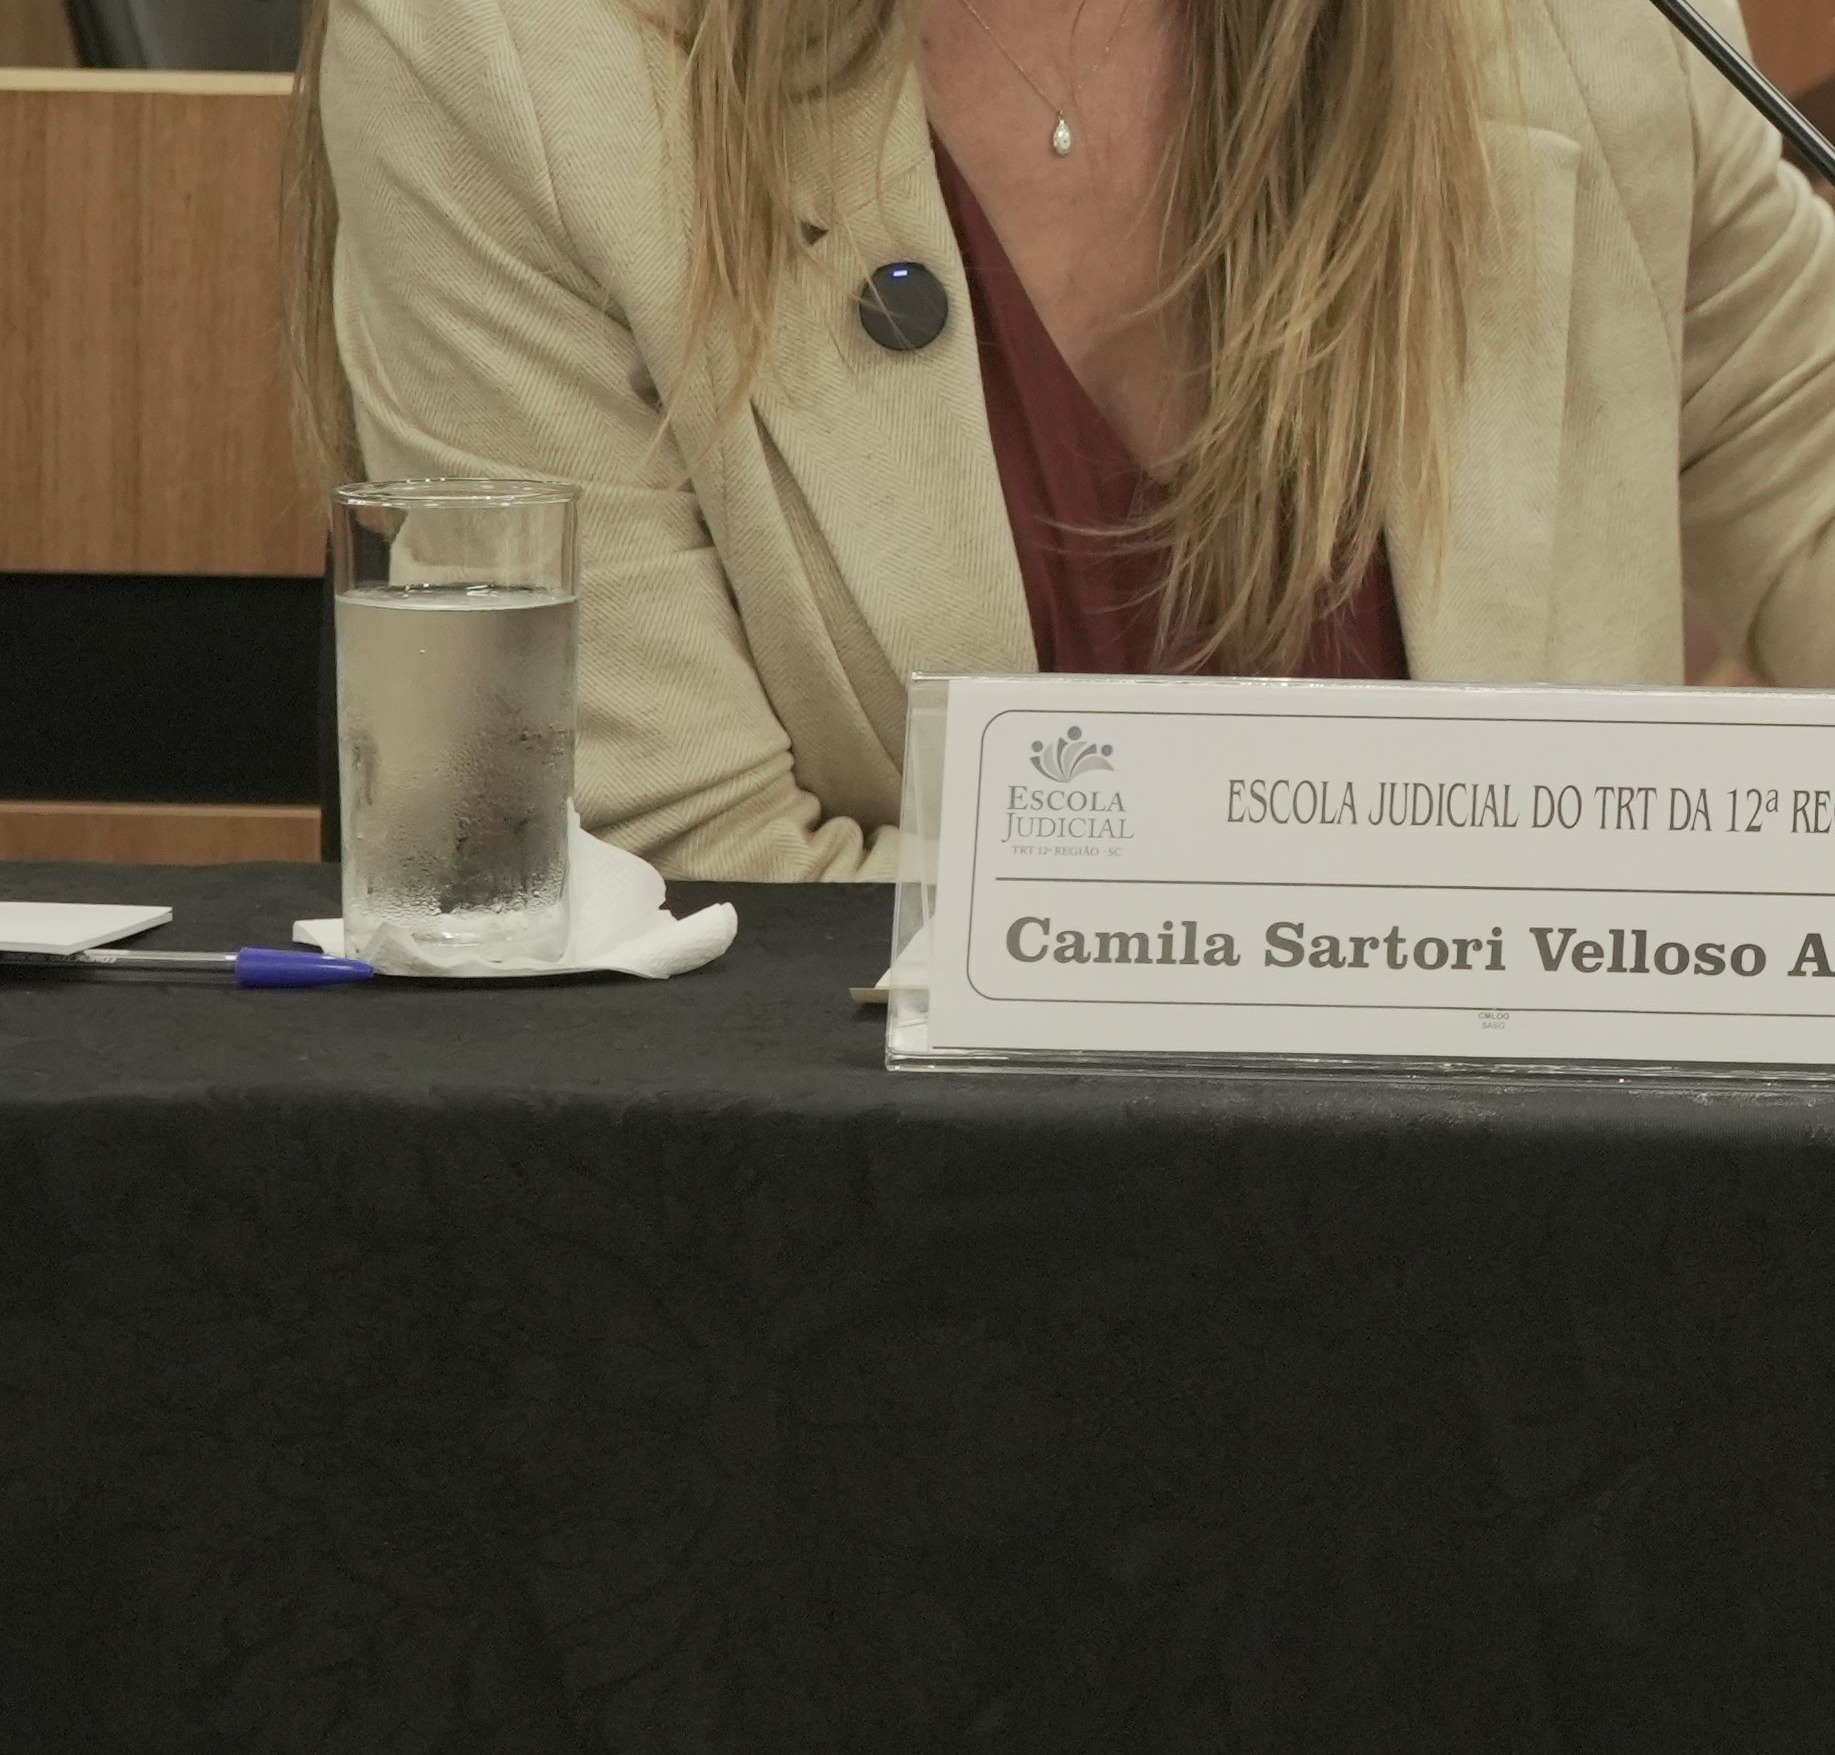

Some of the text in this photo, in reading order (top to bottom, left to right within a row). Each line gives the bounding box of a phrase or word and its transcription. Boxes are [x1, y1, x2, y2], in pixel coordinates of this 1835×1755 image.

[1003, 783, 1128, 812] ESCOLA
[1227, 778, 1358, 825] ESCOLA
[1367, 782, 1519, 828] JUDICIAL
[1531, 784, 1583, 830] DO
[1594, 786, 1658, 831] TRT
[1668, 787, 1713, 832] DA
[1727, 788, 1779, 833] 12ª
[1000, 811, 1136, 844] JUDICIAL
[1005, 916, 1242, 967] Camila
[1264, 921, 1506, 972] Sartori
[1528, 926, 1767, 977] Velloso
